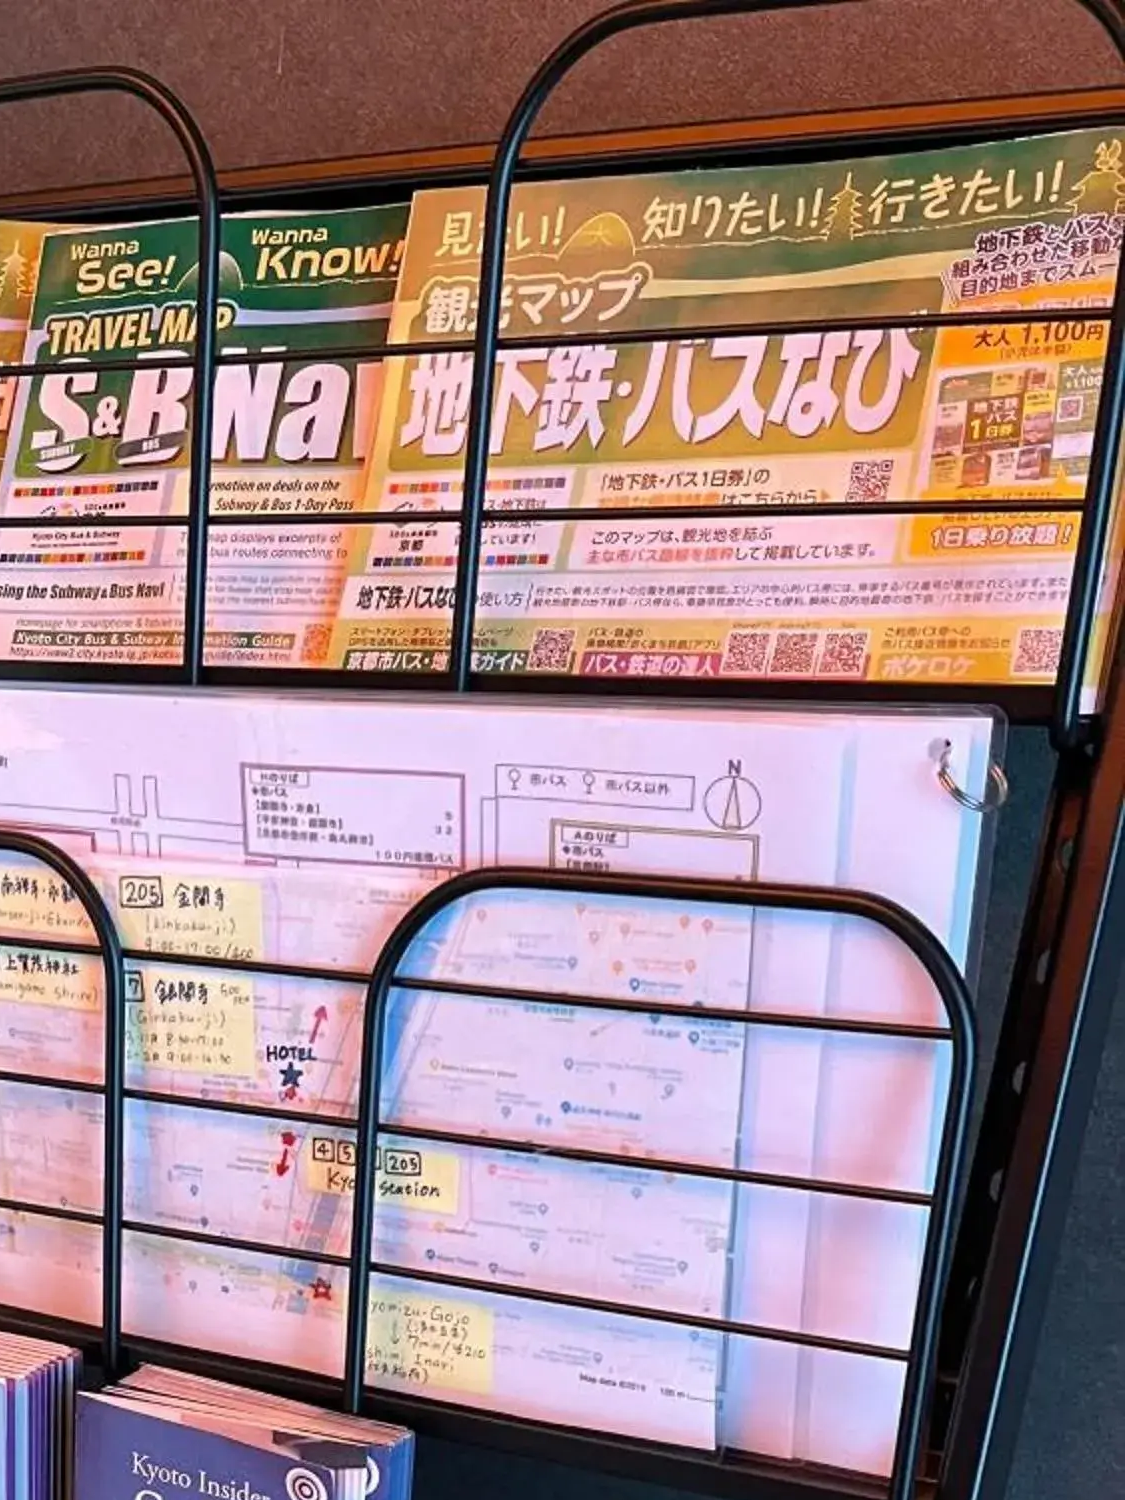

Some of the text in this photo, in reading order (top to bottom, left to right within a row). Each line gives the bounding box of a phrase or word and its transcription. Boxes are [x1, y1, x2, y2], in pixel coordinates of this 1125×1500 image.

[868, 160, 1064, 224] 行きたい!
[641, 188, 822, 242] 知りたい!
[71, 226, 327, 260] Wanna Wanna
[77, 241, 404, 295] See! Know!
[49, 316, 152, 355] TRAVEL
[275, 479, 340, 492] deals the
[215, 498, 354, 513] Subway Pass
[27, 583, 47, 599] the
[136, 582, 165, 598] Navi
[16, 632, 291, 647] Kyoto City Bus Subway Guide
[882, 658, 975, 677] ポケロケ
[728, 760, 742, 775] N
[126, 882, 161, 902] 205
[266, 1045, 317, 1062] HOTEL
[388, 1156, 418, 1171] 205
[131, 1451, 191, 1489] Kyoto
